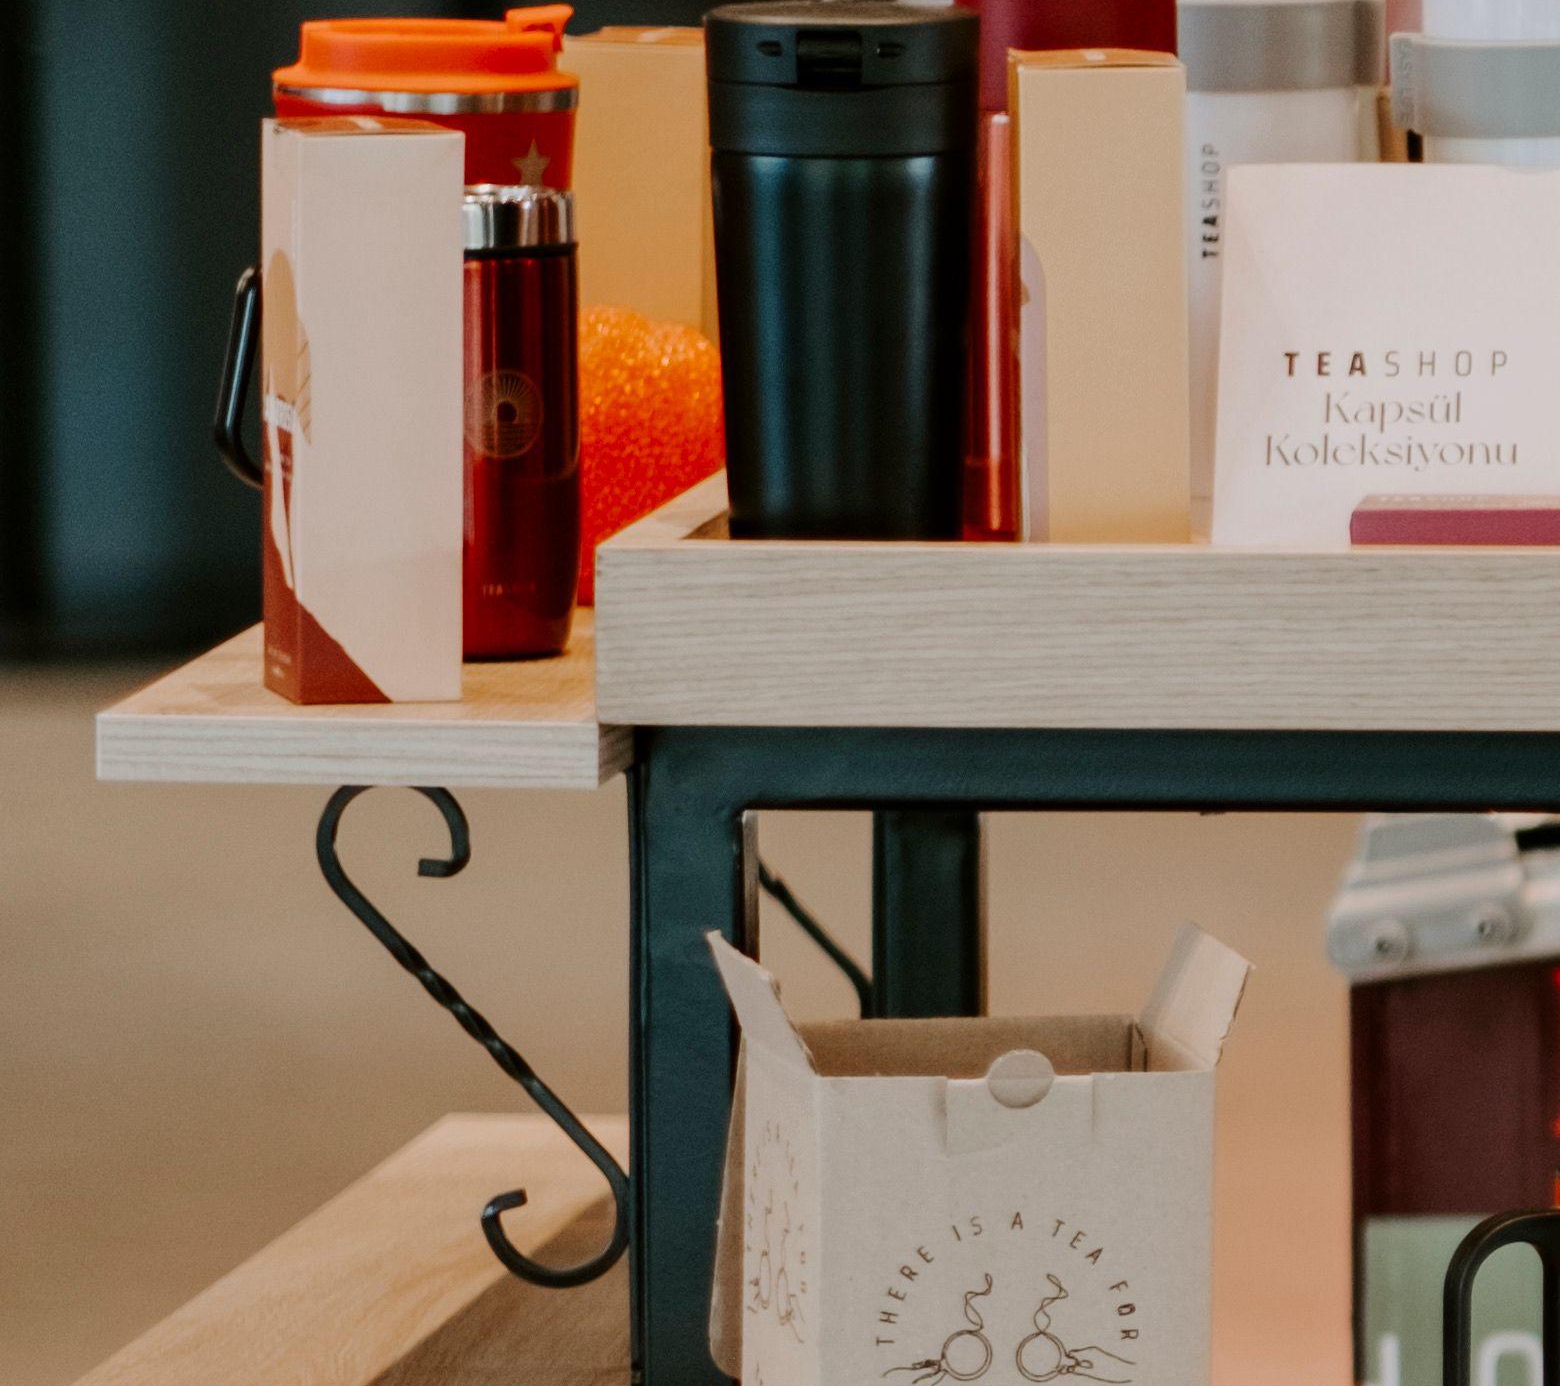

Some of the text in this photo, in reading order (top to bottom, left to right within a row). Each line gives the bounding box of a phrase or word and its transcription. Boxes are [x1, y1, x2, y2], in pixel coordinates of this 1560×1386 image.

[1202, 142, 1221, 260] TEASHOP
[1284, 350, 1509, 378] TEASHOP
[1324, 391, 1462, 434] Kapsül
[1264, 433, 1519, 472] Koleksiyonu
[876, 1211, 1140, 1347] THERE IS A TEA FOR
